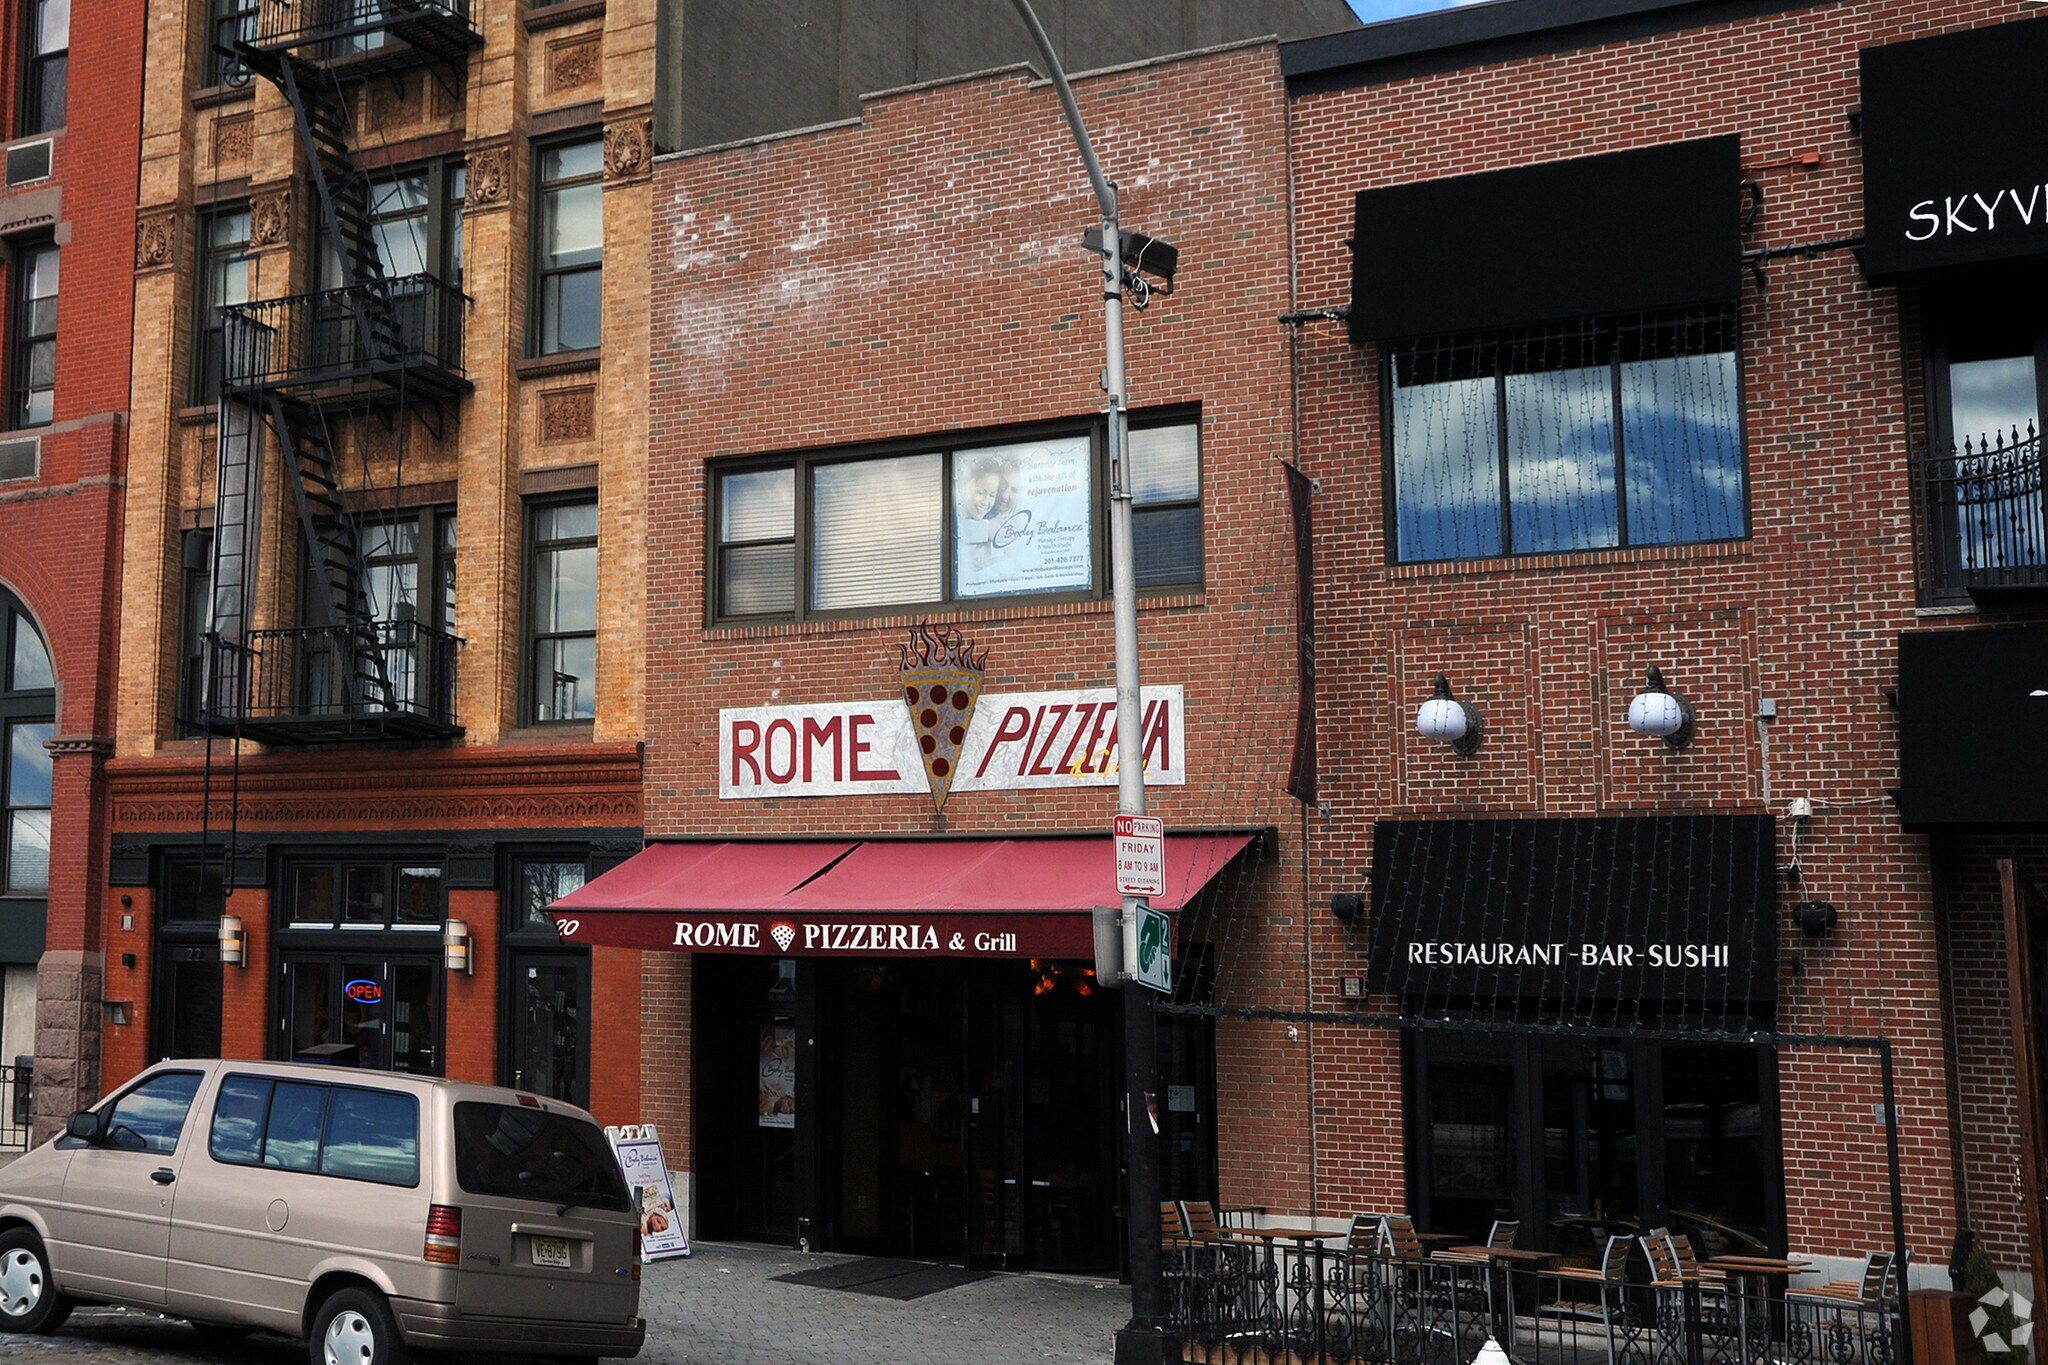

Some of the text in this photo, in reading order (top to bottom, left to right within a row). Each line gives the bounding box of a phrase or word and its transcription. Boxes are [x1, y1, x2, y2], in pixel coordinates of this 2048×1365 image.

[1058, 457, 1075, 466] them
[1028, 473, 1043, 483] with
[1044, 472, 1054, 481] the
[1027, 483, 1077, 497] rejuvenation
[1004, 520, 1084, 546] Body Balance
[1044, 555, 1084, 565] 201-420-7277
[732, 714, 901, 787] ROME
[1117, 820, 1159, 834] NO PARKING
[1122, 842, 1155, 854] FRIDAY
[1117, 860, 1159, 872] 8 AM TO 9 AM
[1137, 877, 1160, 885] CLEANING
[672, 921, 1017, 952] ROME PIZZERIA & Grill
[1162, 919, 1168, 947] 2
[347, 985, 383, 999] OPEN
